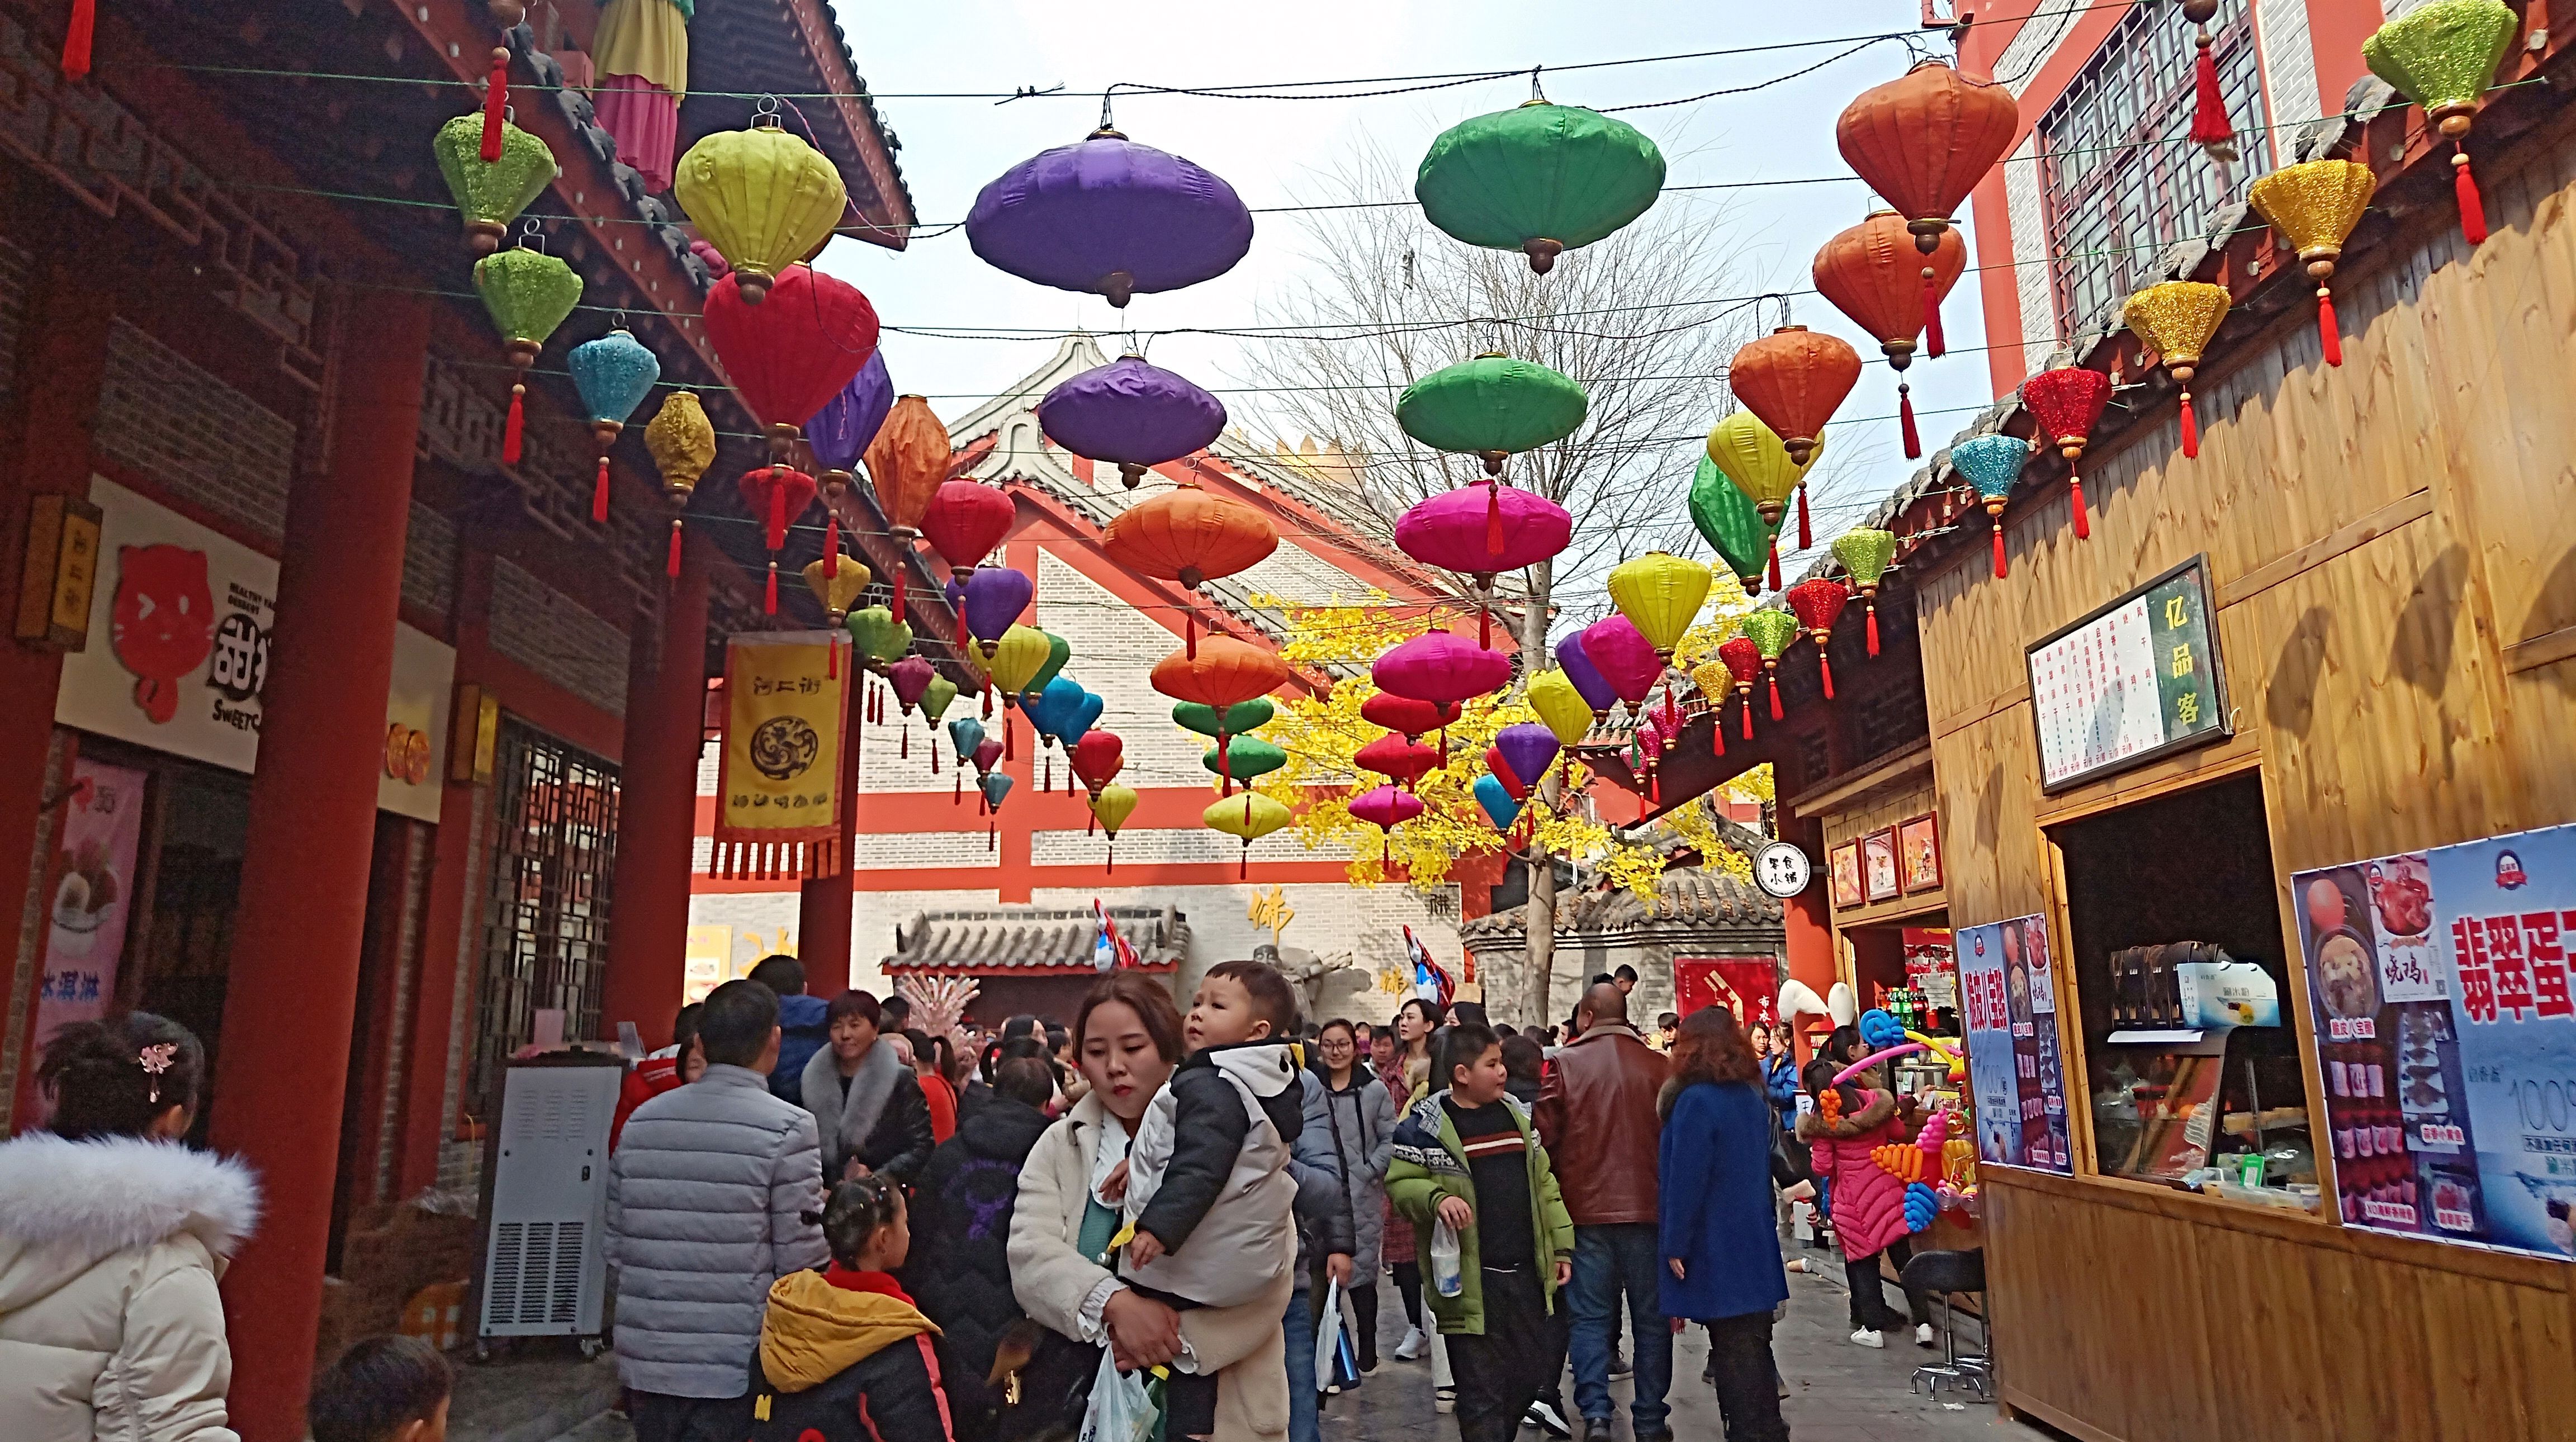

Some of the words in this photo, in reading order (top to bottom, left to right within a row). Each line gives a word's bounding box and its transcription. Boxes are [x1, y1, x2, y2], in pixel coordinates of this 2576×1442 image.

[2109, 620, 2122, 691] 蒜香小黄鱼
[2137, 606, 2151, 679] 风干鸡
[2165, 595, 2199, 725] 亿品客
[2154, 734, 2159, 744] 只
[1247, 885, 1295, 946] 佛
[1379, 966, 1409, 1007] 佛
[2385, 952, 2421, 985] 烧鸡
[1758, 995, 1772, 1027] 布衣
[2032, 979, 2044, 1002] 烧鸡
